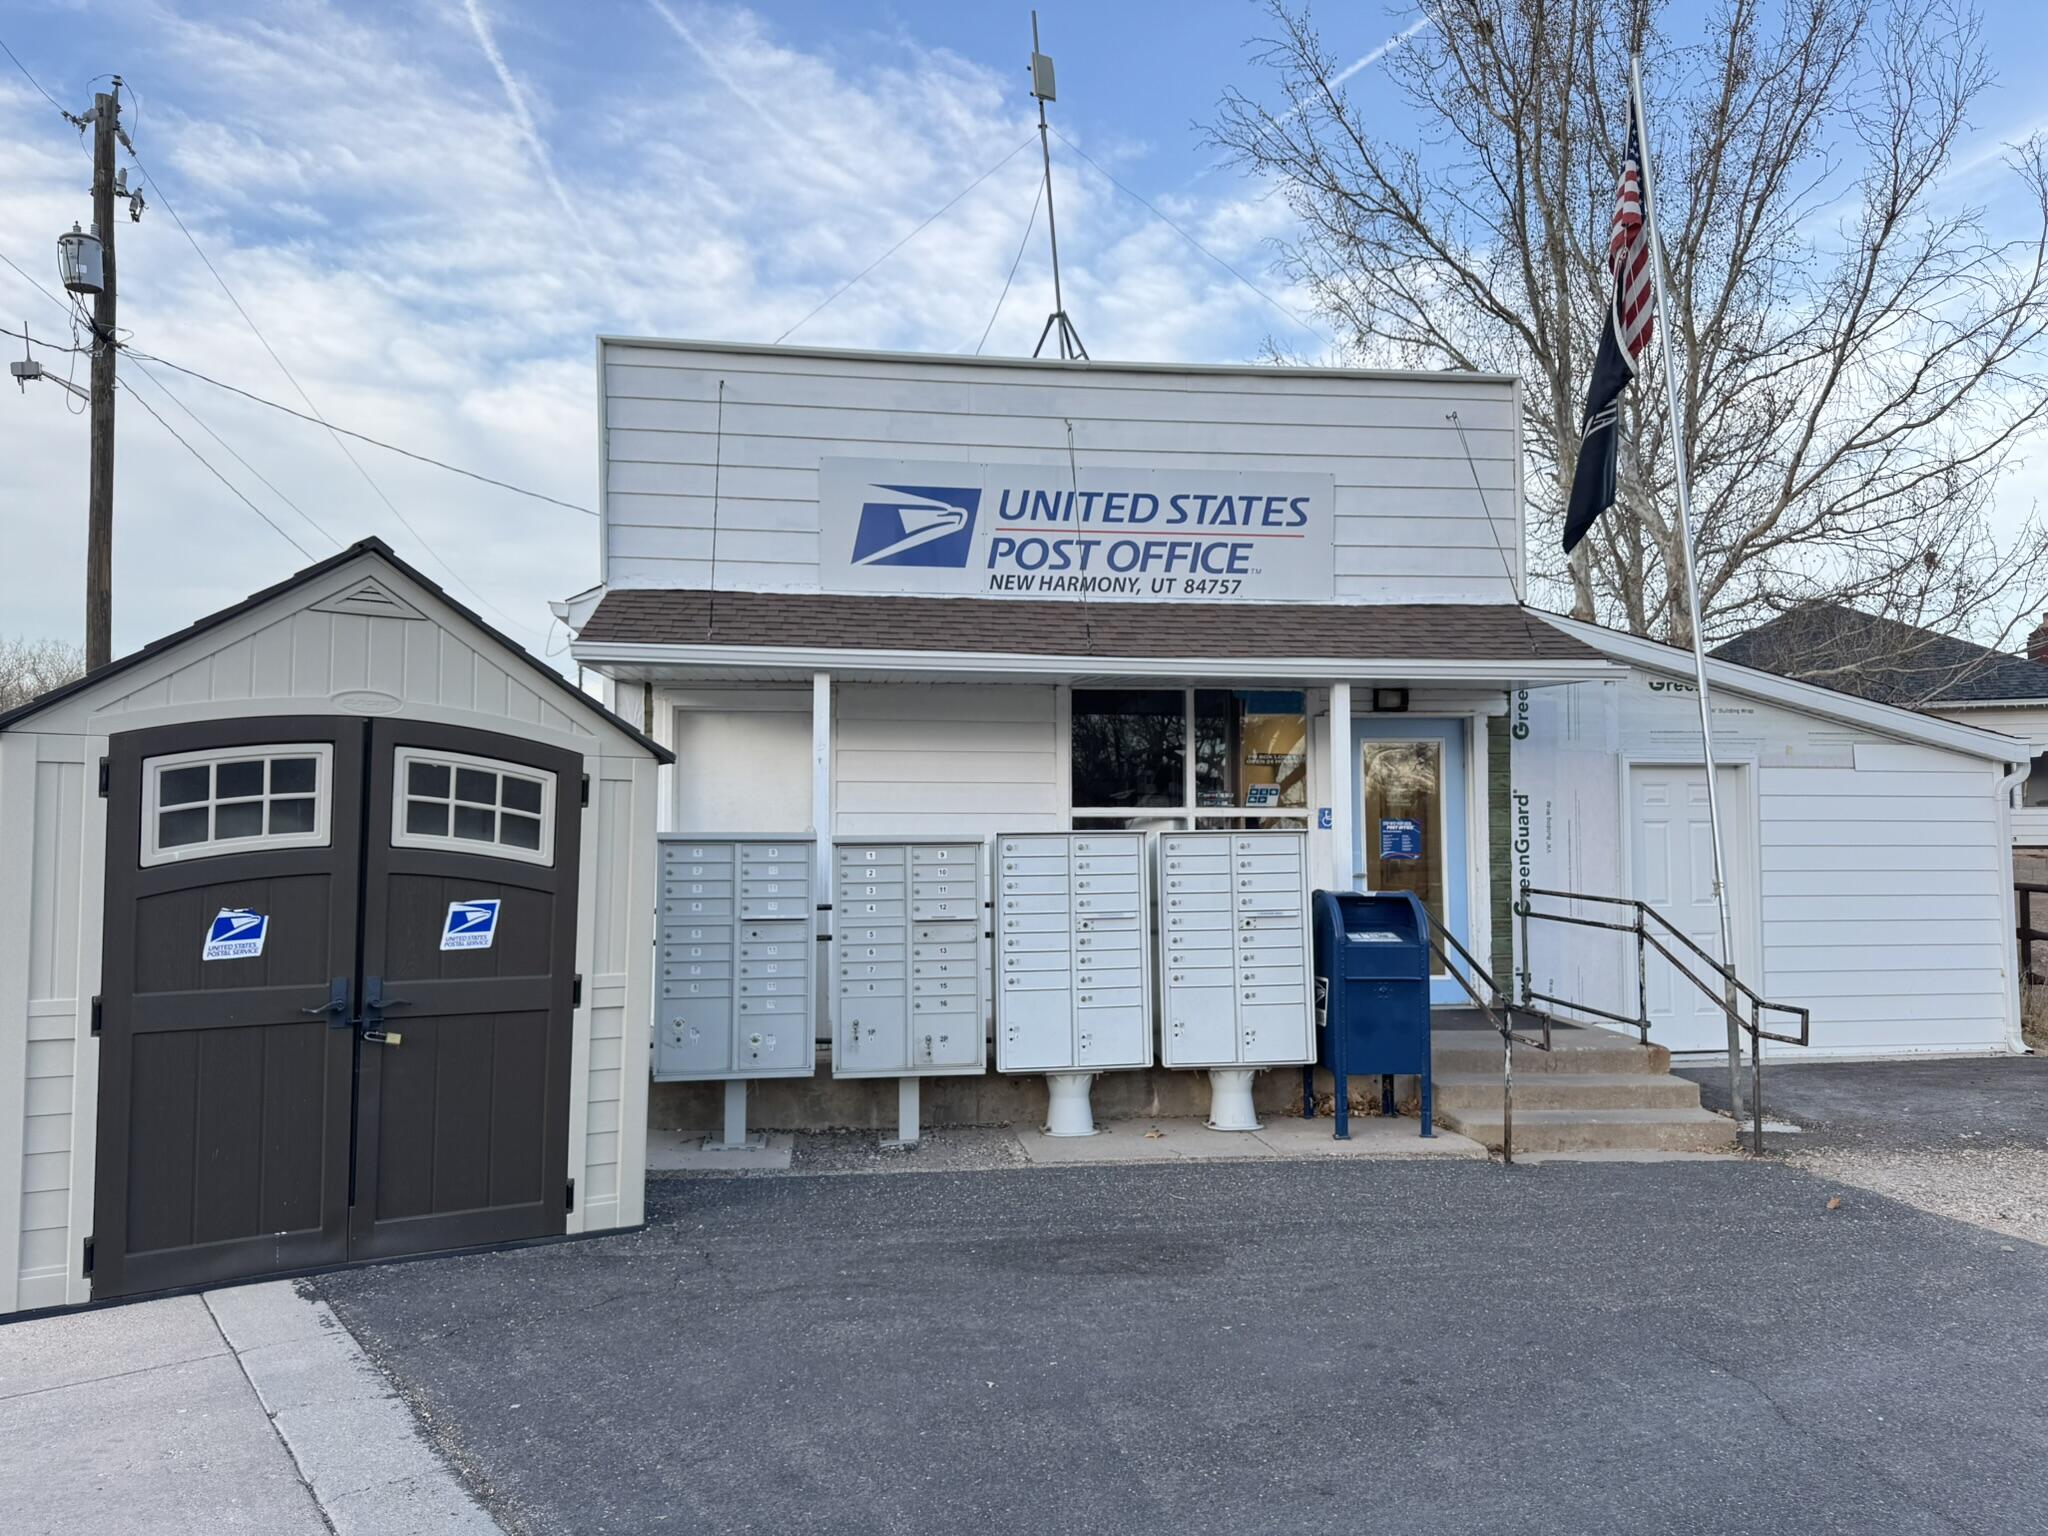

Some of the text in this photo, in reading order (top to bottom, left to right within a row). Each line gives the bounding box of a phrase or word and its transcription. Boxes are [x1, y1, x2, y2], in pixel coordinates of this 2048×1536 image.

[999, 489, 1310, 527] UNITED STATES
[987, 537, 1102, 571] POST
[1106, 540, 1254, 574] OFFICE
[989, 574, 1242, 596] NEW HARMONY, UT 84757
